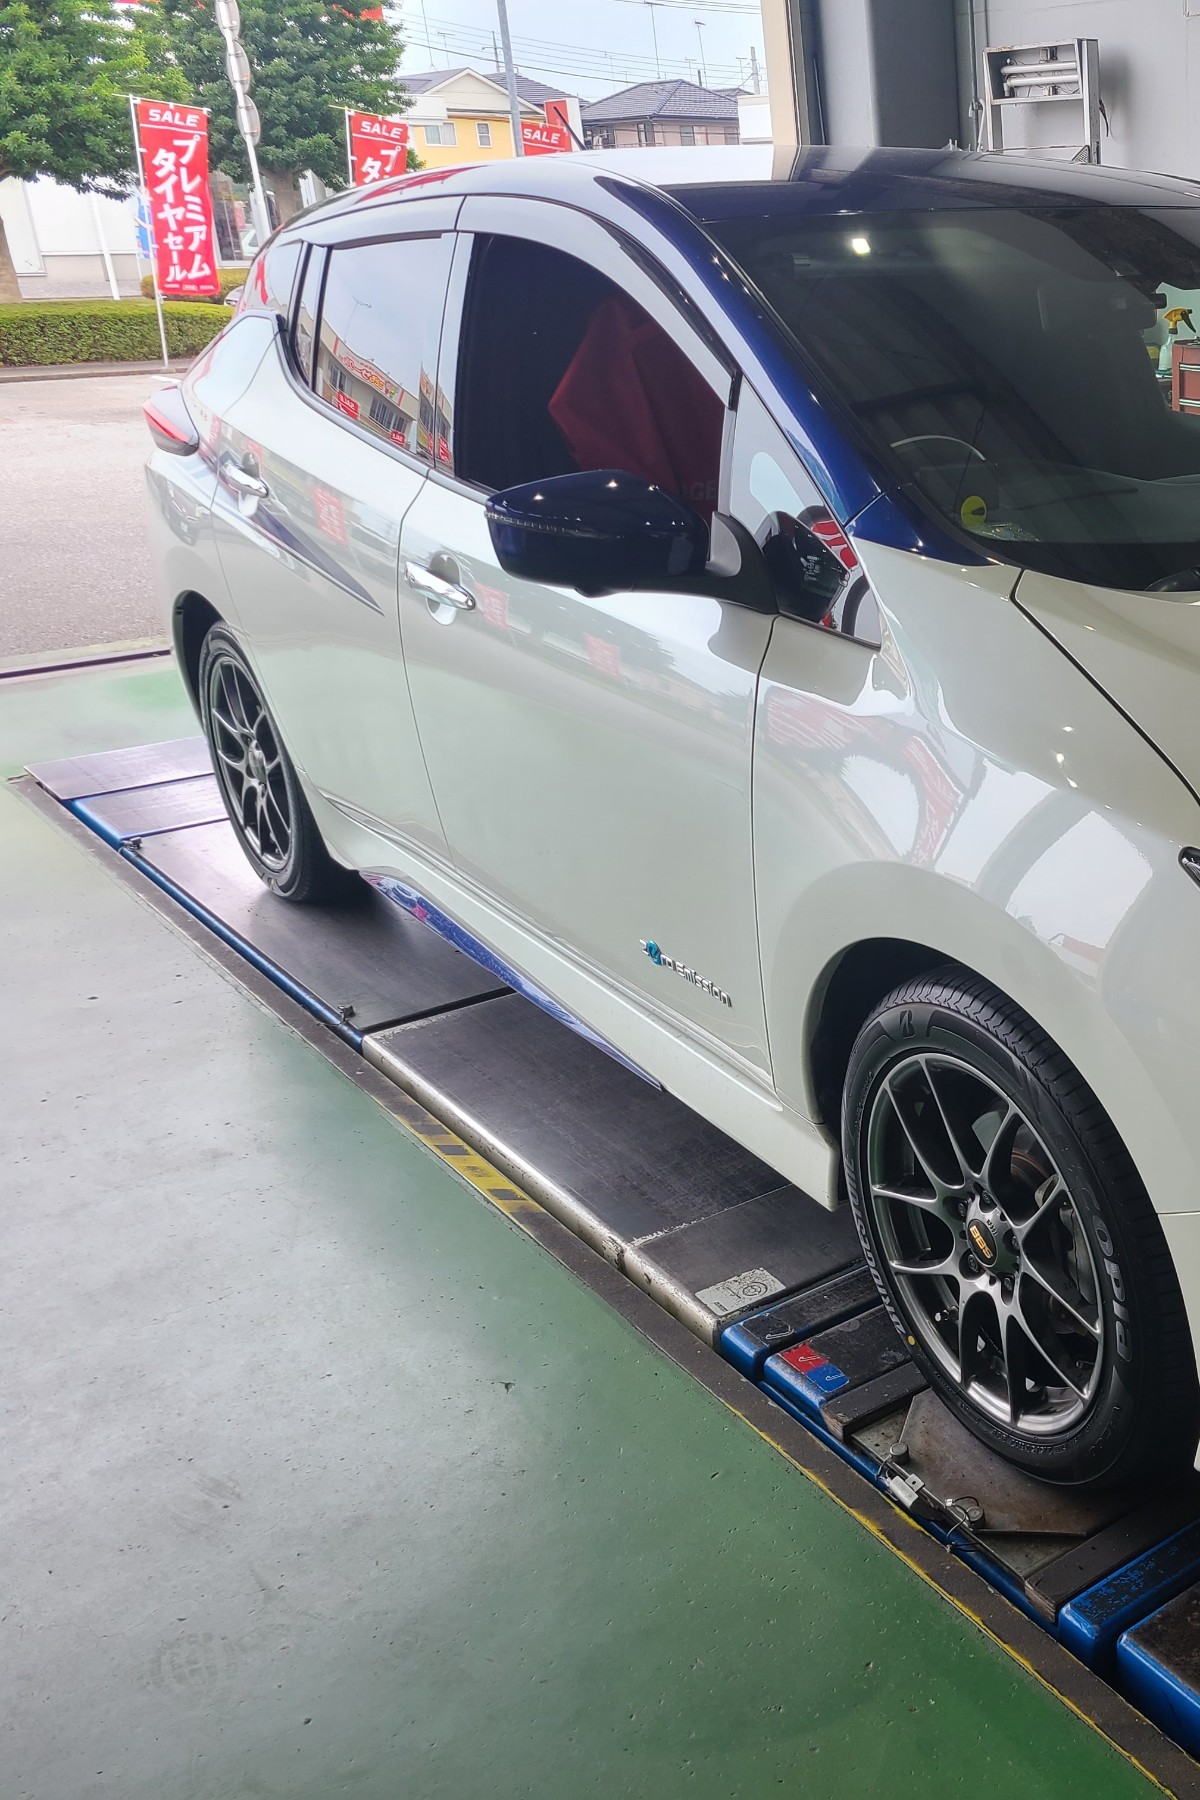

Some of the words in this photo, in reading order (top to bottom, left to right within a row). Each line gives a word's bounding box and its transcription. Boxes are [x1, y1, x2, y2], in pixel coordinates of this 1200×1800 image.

[148, 108, 200, 128] SALE
[360, 120, 403, 139] SALE
[522, 127, 561, 145] SALE
[152, 148, 188, 282] タイヤセール
[173, 134, 211, 280] プレミアム
[675, 961, 733, 1008] Emission
[969, 1225, 993, 1259] BBS
